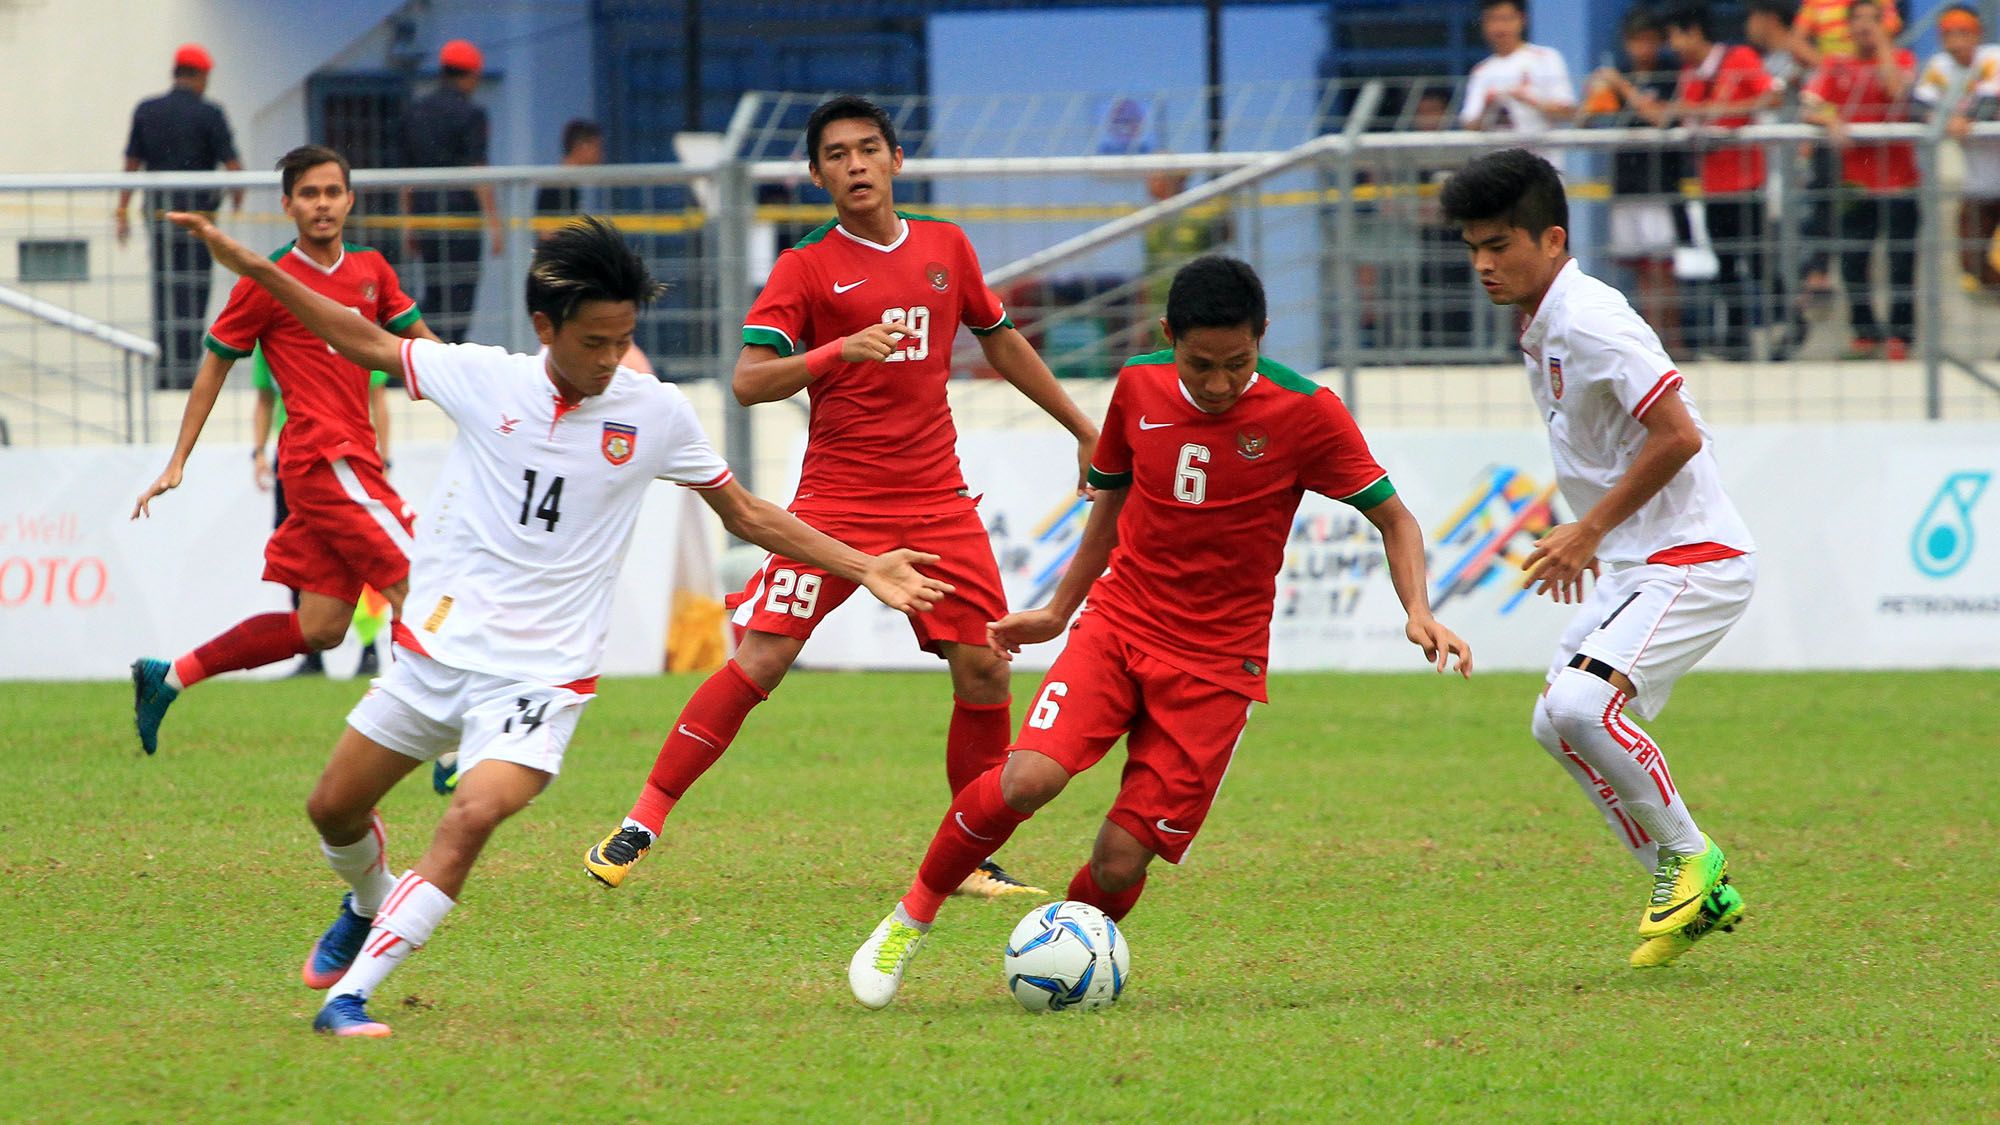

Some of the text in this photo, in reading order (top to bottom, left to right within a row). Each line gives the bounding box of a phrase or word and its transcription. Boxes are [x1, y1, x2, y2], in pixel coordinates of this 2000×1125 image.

[881, 305, 930, 362] 29
[519, 469, 566, 533] 14
[1173, 443, 1211, 505] 6
[764, 568, 823, 619] 29
[503, 696, 552, 735] 14
[1028, 681, 1069, 730] 6
